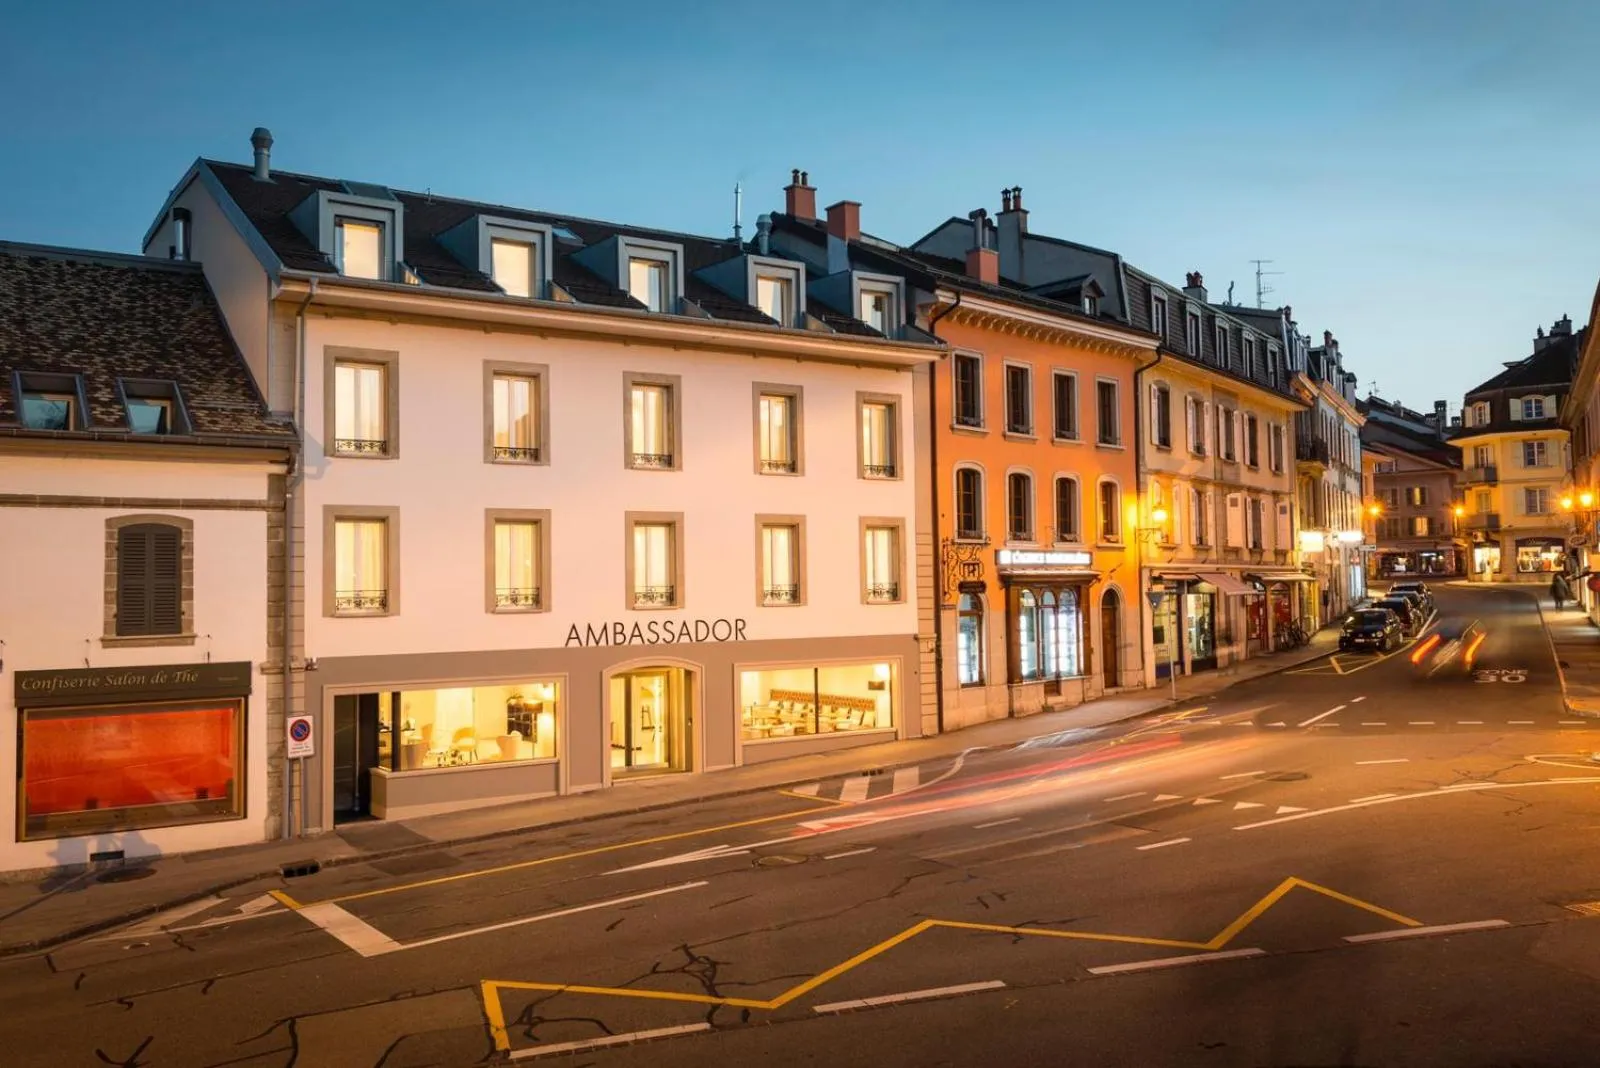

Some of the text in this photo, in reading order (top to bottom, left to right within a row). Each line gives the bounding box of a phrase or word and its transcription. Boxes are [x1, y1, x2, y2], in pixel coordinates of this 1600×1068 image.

[566, 619, 747, 646] AMBASSADOR
[21, 675, 100, 693] Confiserie
[104, 672, 145, 686] Salon
[151, 670, 168, 684] de
[1474, 675, 1526, 683] 30
